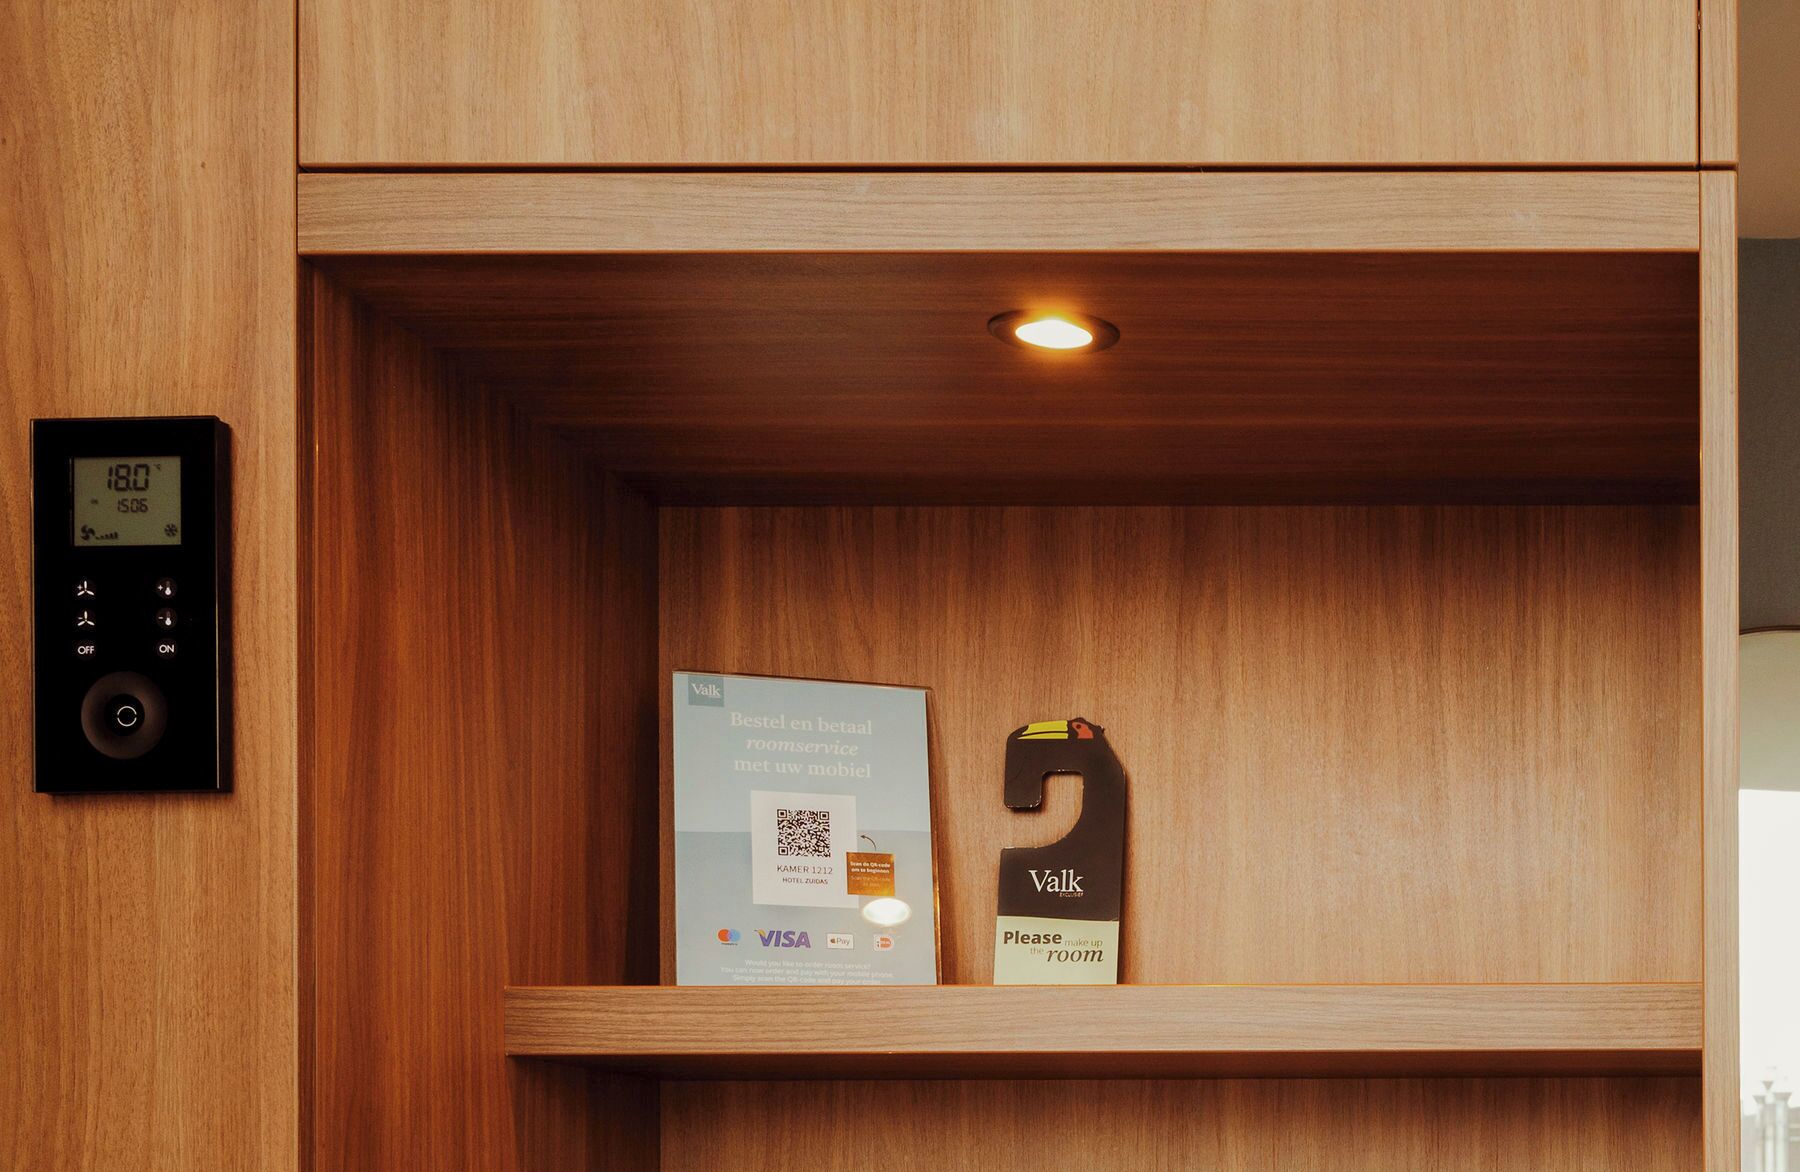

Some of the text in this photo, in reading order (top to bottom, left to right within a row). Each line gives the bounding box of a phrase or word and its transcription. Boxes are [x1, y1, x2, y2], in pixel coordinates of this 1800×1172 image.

[77, 645, 95, 655] OFF
[158, 644, 175, 654] ON
[691, 683, 721, 698] Valk
[730, 711, 872, 736] Bestel en betaal
[745, 738, 859, 757] roomservice
[734, 759, 871, 779] met uw mobiel
[777, 865, 833, 875] KAMER 1212
[1028, 869, 1084, 893] Valk
[755, 930, 811, 949] VISA
[836, 937, 850, 946] Pay
[1003, 931, 1103, 950] Please make up
[1030, 947, 1104, 963] the room
